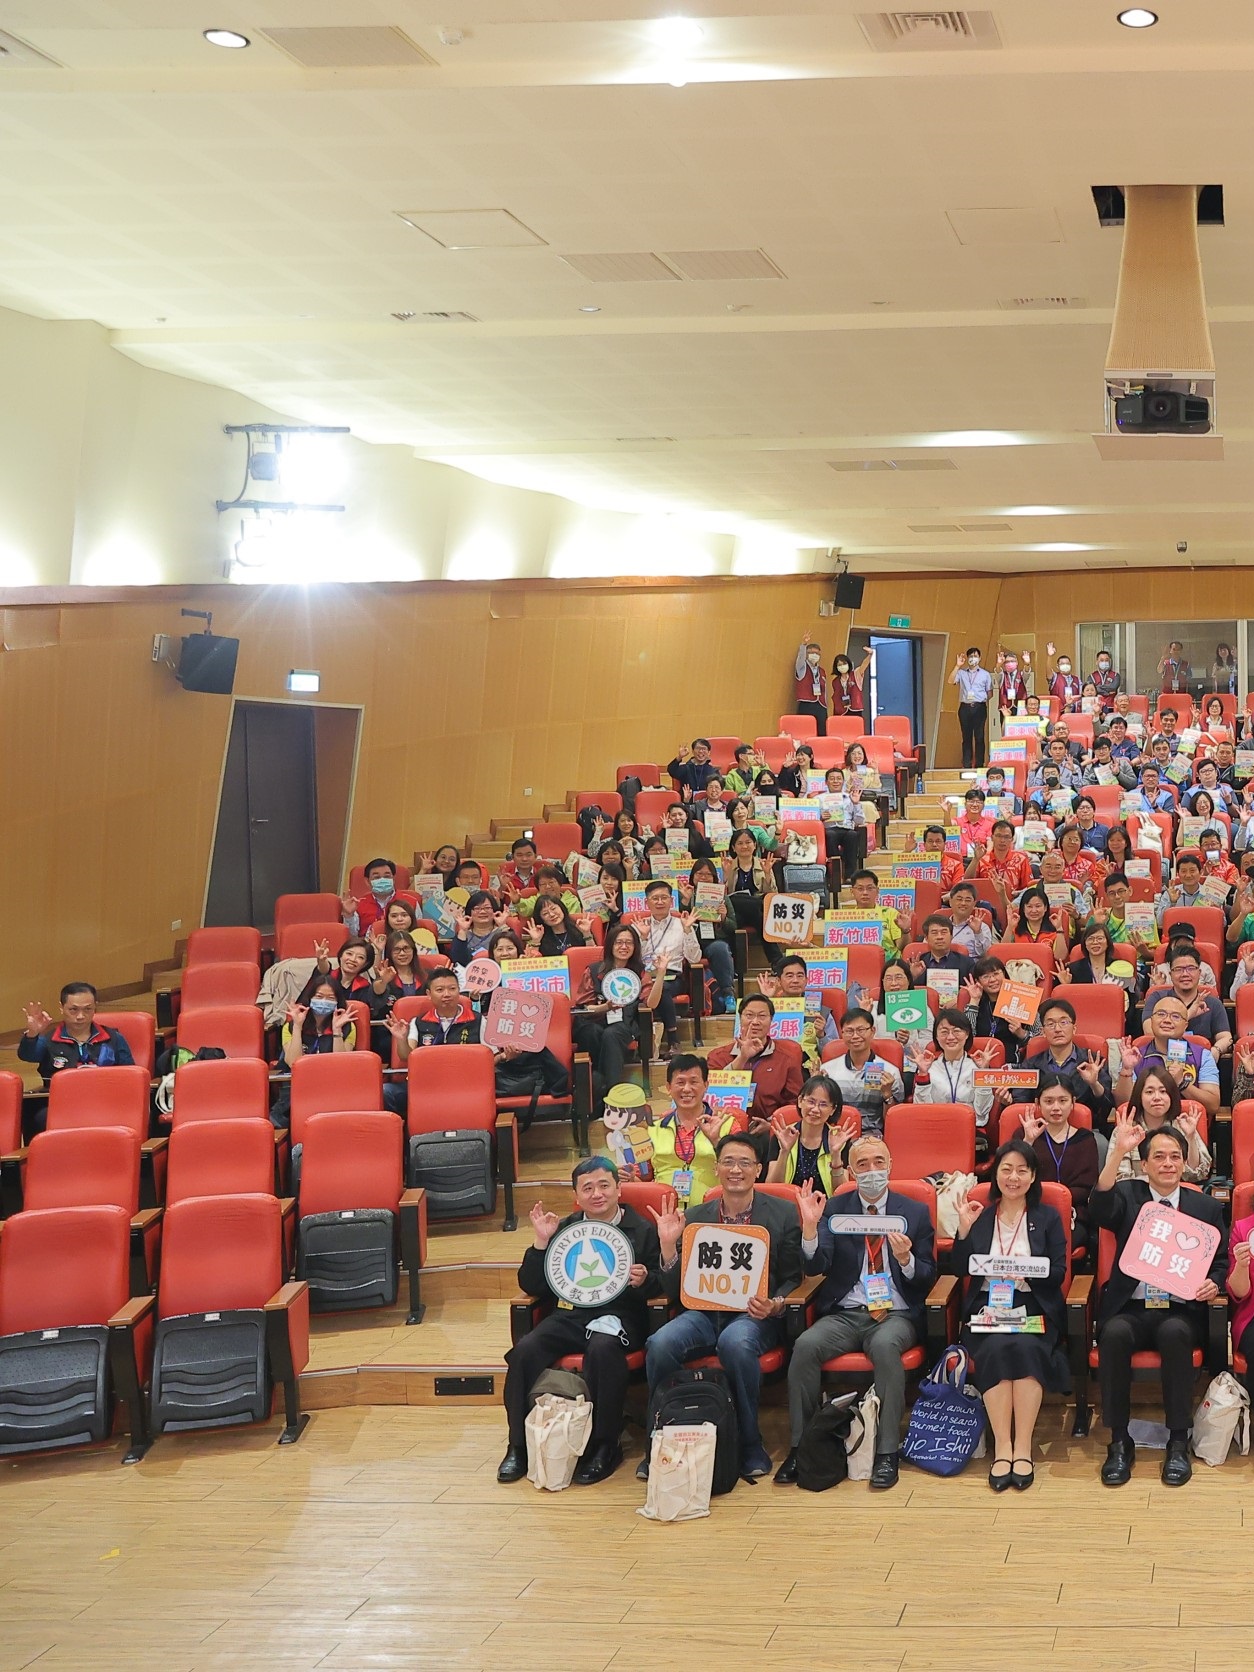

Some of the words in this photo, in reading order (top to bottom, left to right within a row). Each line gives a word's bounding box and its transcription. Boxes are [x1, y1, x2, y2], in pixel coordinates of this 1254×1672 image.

[895, 866, 938, 882] 高雄市
[877, 893, 914, 909] 南市
[773, 903, 805, 920] 防災
[774, 921, 803, 933] NO.1
[828, 927, 879, 944] 新竹縣
[505, 976, 566, 992] 臺北市
[807, 968, 843, 986] 隆市
[501, 998, 518, 1016] 我
[887, 993, 896, 1004] 13
[496, 1017, 536, 1039] 防災
[703, 1093, 743, 1110] 北市
[1149, 1218, 1173, 1243] 我
[552, 1235, 572, 1290] MINISTRY
[572, 1226, 588, 1239] OF
[591, 1226, 628, 1280] EDUCATION
[698, 1241, 753, 1271] 防災
[1138, 1241, 1193, 1279] 防災
[569, 1280, 618, 1302] 教育部
[698, 1273, 751, 1295] NO.1
[917, 1400, 946, 1409] ravel
[947, 1404, 976, 1415] around
[911, 1409, 940, 1420] world
[938, 1413, 948, 1422] in
[949, 1416, 978, 1427] search
[909, 1420, 946, 1433] ourmet
[947, 1425, 970, 1437] food.
[928, 1436, 972, 1455] Ishii
